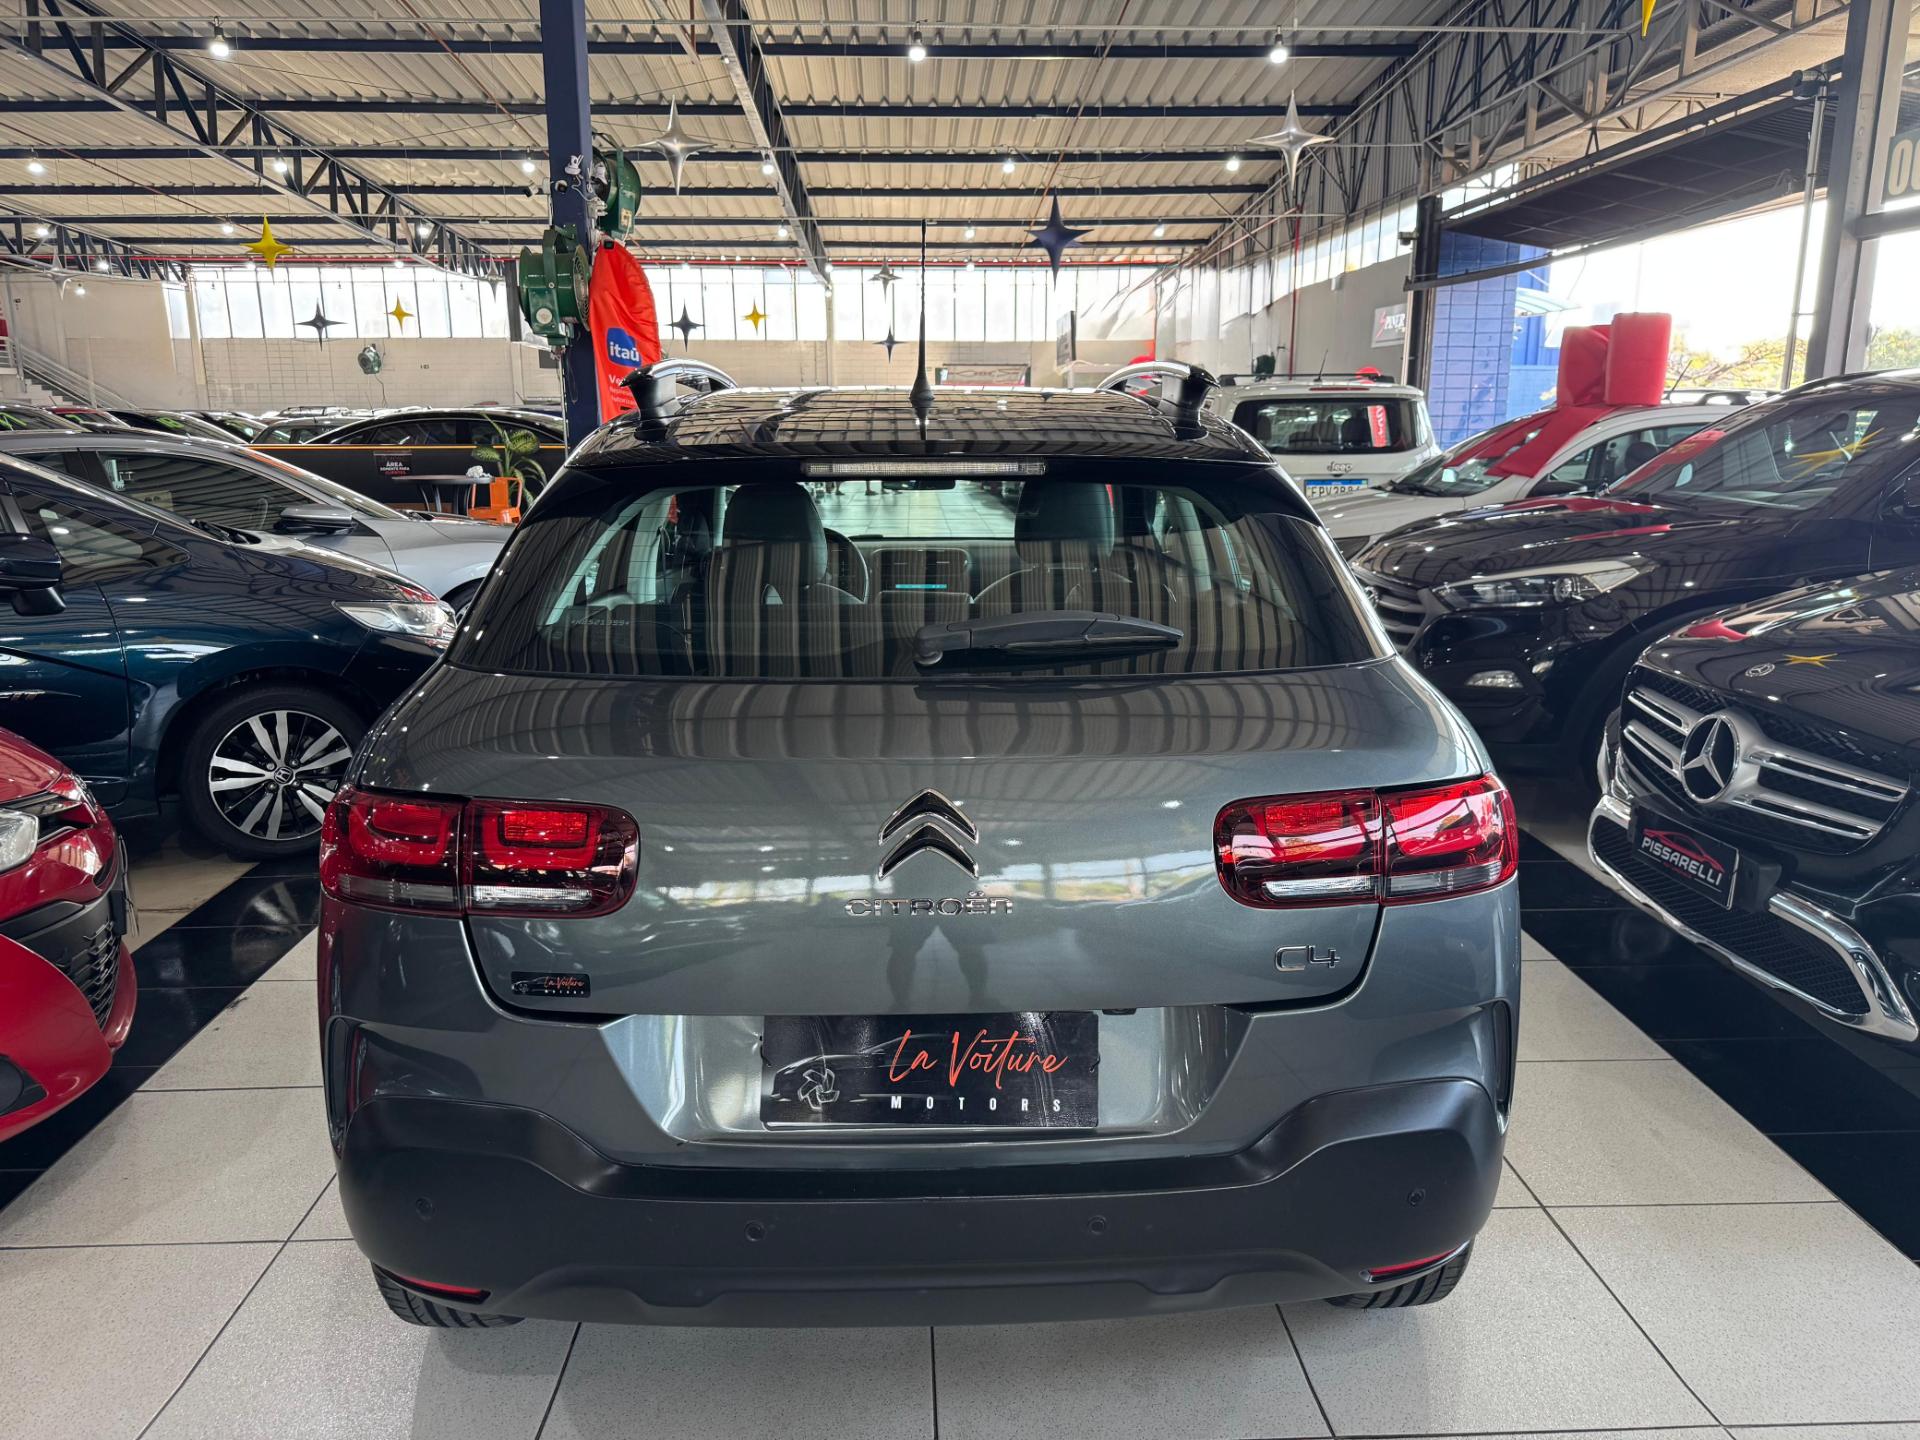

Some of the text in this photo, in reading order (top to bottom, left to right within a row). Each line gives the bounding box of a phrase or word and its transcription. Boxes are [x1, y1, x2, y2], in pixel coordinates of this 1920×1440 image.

[609, 341, 640, 362] itaú
[1641, 836, 1723, 886] PISSARELLI
[845, 891, 1013, 916] CITROËN
[1275, 944, 1341, 972] C4
[889, 1029, 1069, 1090] La Voiture
[890, 1095, 1061, 1112] MOTORS
